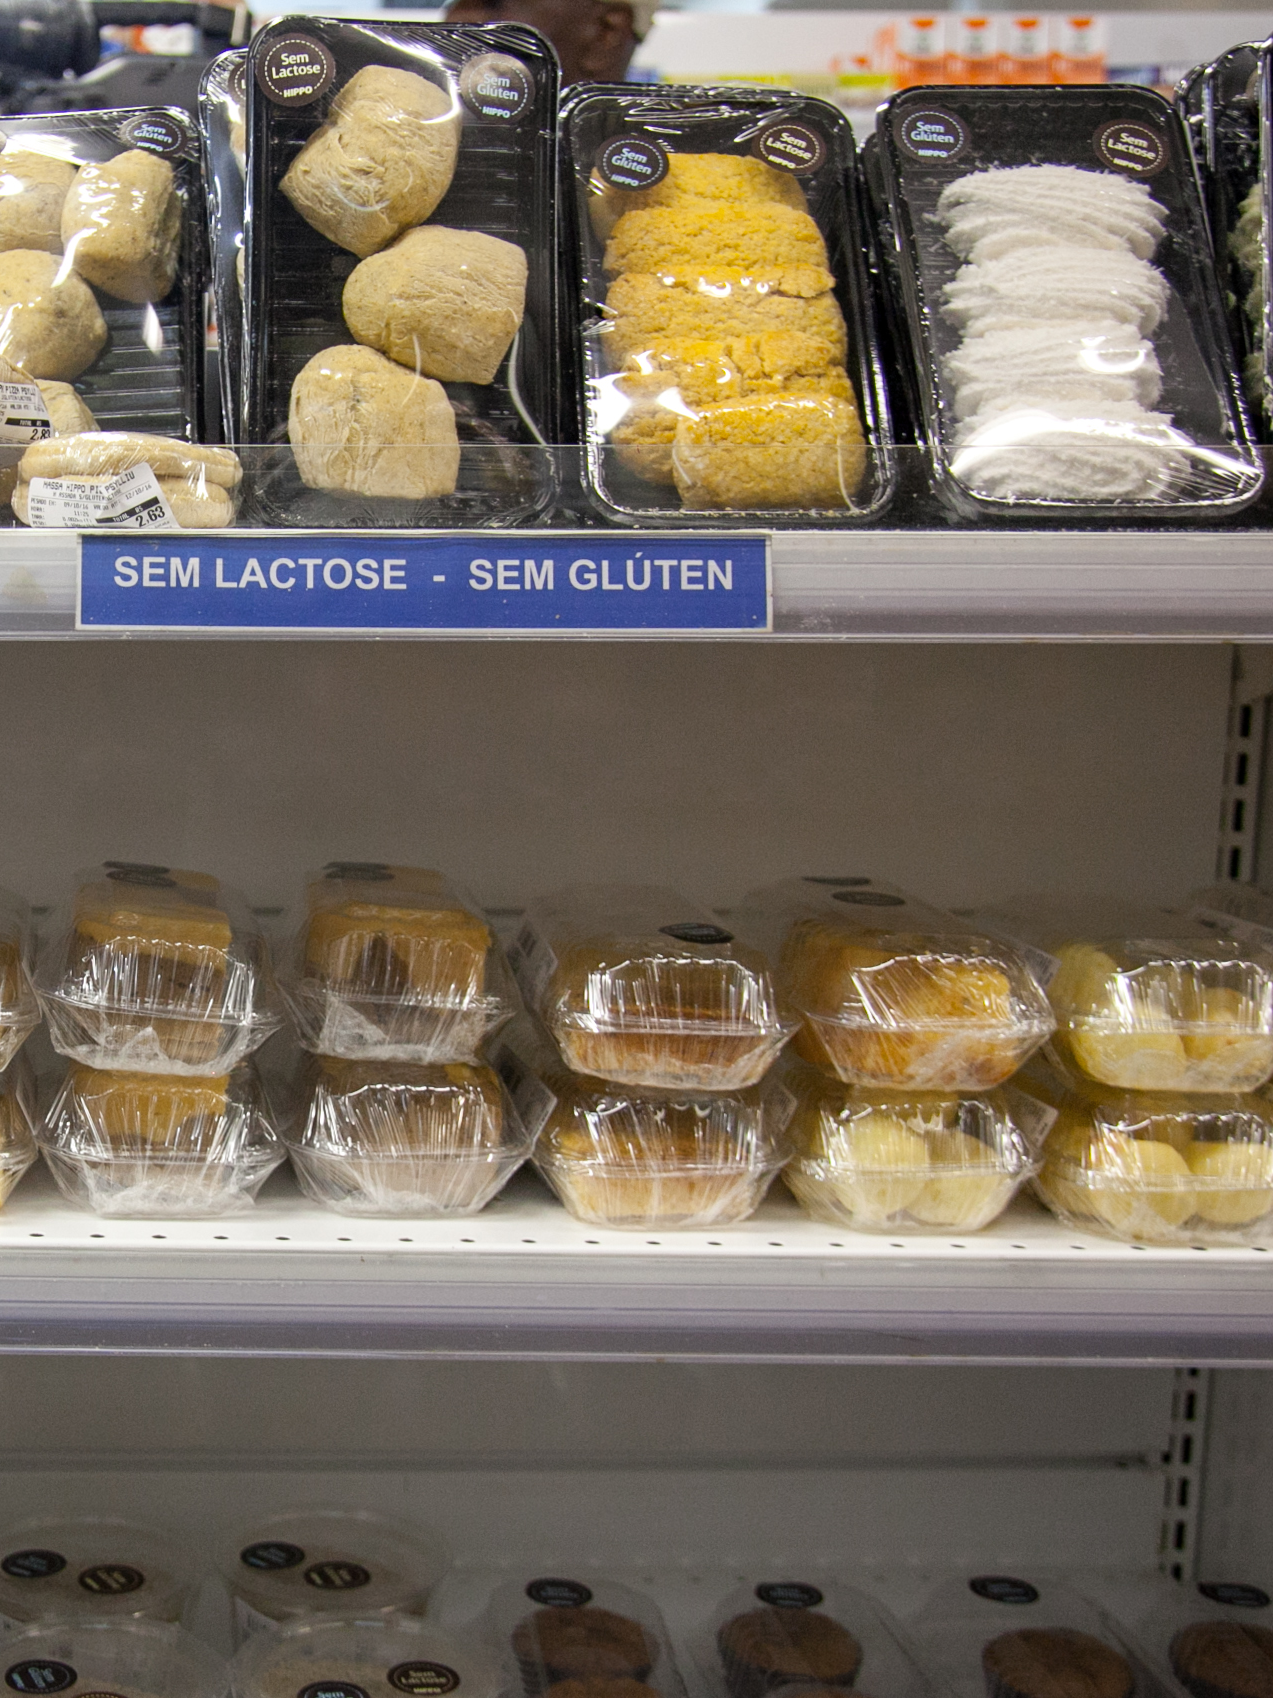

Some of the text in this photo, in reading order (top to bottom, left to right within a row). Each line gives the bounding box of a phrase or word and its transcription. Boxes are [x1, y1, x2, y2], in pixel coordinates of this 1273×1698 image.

[281, 53, 309, 66] Sem
[271, 64, 321, 80] Lactose
[483, 72, 510, 88] Sem
[283, 85, 314, 98] HIPPO
[476, 84, 518, 101] Glúten
[482, 106, 511, 118] HIPPO
[140, 123, 166, 134] Sem
[916, 121, 945, 134] Sem
[134, 129, 173, 144] Glúten
[779, 132, 807, 148] Sem
[910, 130, 954, 144] Glúten
[1119, 132, 1148, 149] Sem
[136, 141, 164, 152] HIPPO
[766, 136, 812, 160] Lactose
[917, 148, 948, 158] HIPPO
[1107, 138, 1156, 160] Lactose
[620, 148, 648, 163] Sem
[768, 154, 797, 170] HIPPO
[610, 154, 653, 175] Glúten
[1112, 156, 1144, 172] HIPPO
[610, 174, 639, 187] HIPPO
[42, 480, 64, 490] MASSA
[66, 484, 86, 494] HIPPO
[104, 470, 136, 493] PSYLLIU
[64, 502, 89, 510] 09/10/16
[125, 484, 152, 500] 12/10/16
[74, 510, 90, 518] 11:25
[112, 512, 130, 522] TOTAL
[136, 506, 166, 528] 2,63
[113, 551, 733, 591] SEM LACTOSE - SEM GLÚTEN
